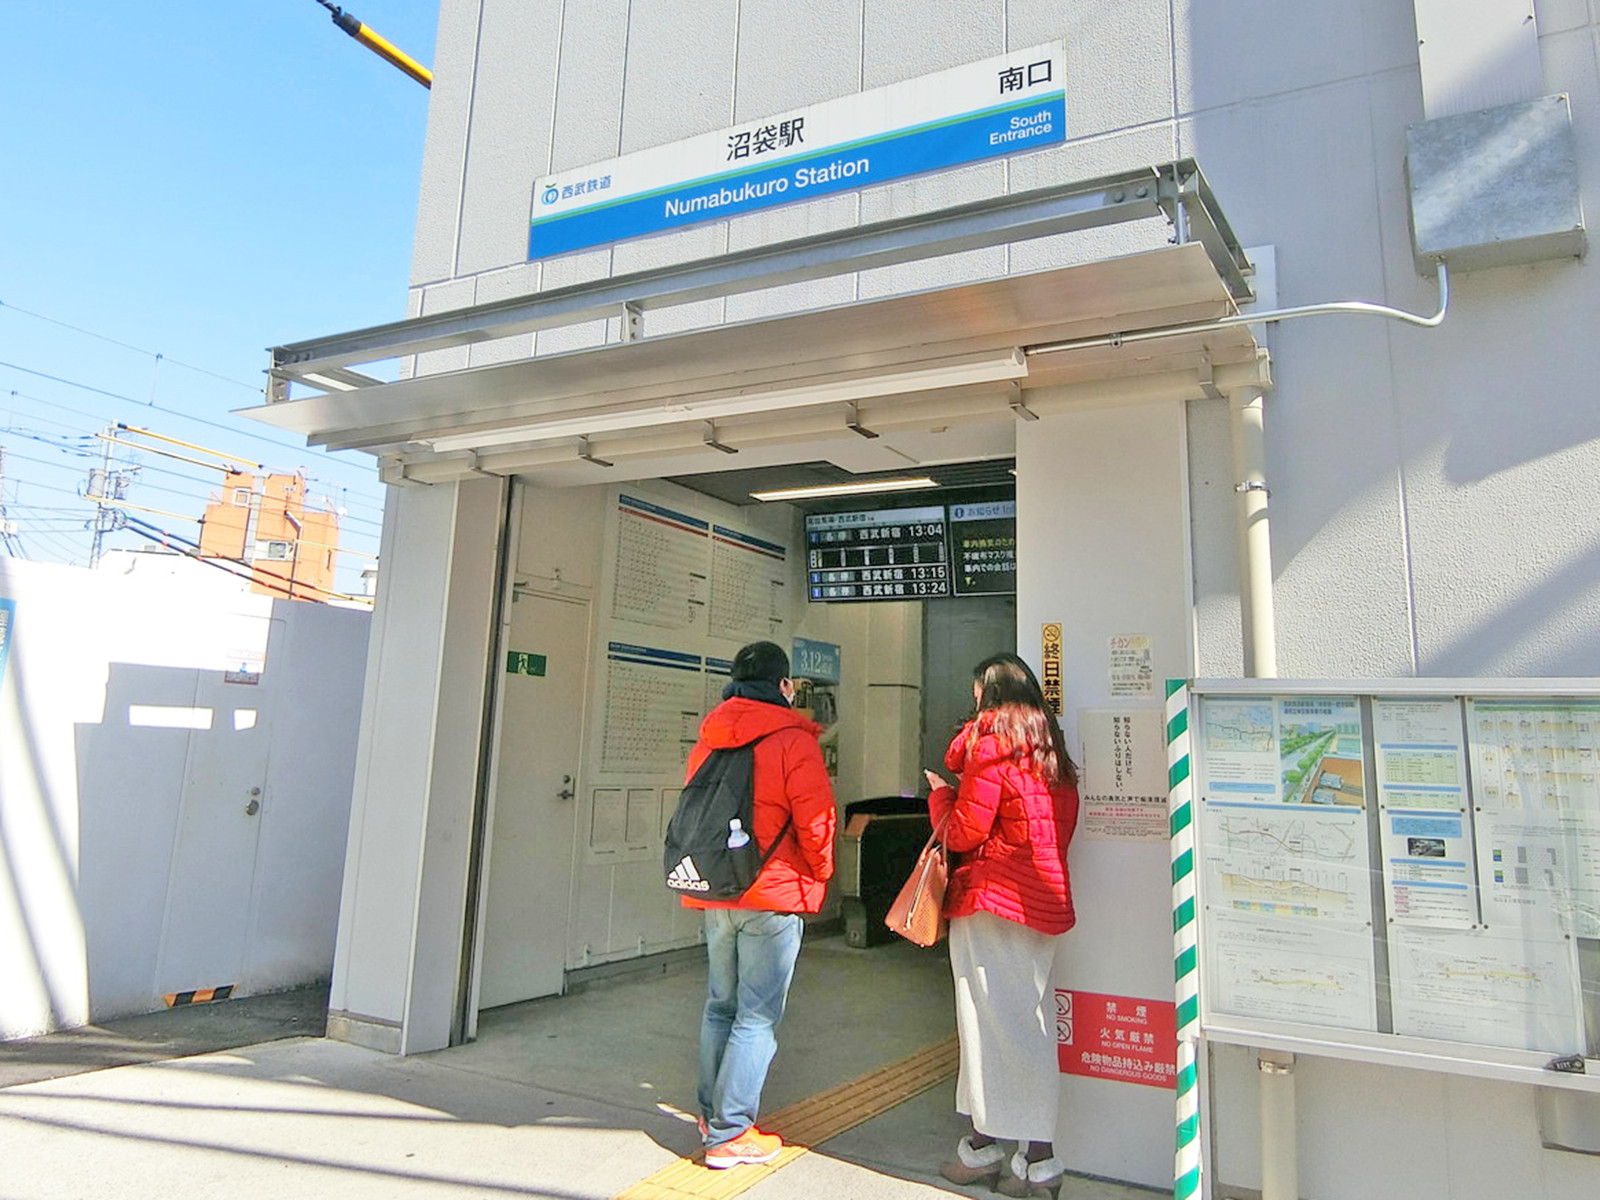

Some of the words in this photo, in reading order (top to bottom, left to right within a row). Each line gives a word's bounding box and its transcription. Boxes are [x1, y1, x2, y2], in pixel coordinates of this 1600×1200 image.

[998, 59, 1052, 94] 南口
[1009, 110, 1052, 130] South
[726, 117, 805, 161] 沼袋駅
[989, 123, 1053, 146] Entrance
[561, 175, 612, 199] 西武鉄道
[664, 177, 789, 218] Numabukuro
[794, 158, 870, 189] Station
[909, 524, 943, 537] 13:04
[911, 566, 946, 579] 13:15
[911, 581, 947, 595] 13:24
[667, 878, 710, 892] adidas
[1106, 1002, 1147, 1018] 禁煙
[1117, 1015, 1148, 1025] SMOKING
[1100, 1027, 1154, 1044] 火気厳禁
[1112, 1042, 1130, 1050] OPEN
[1131, 1045, 1153, 1053] FLAME
[1081, 1051, 1175, 1075] 危険物品持込み厳禁
[1101, 1066, 1141, 1078] DANGEROUS
[1142, 1073, 1167, 1082] GOODS
